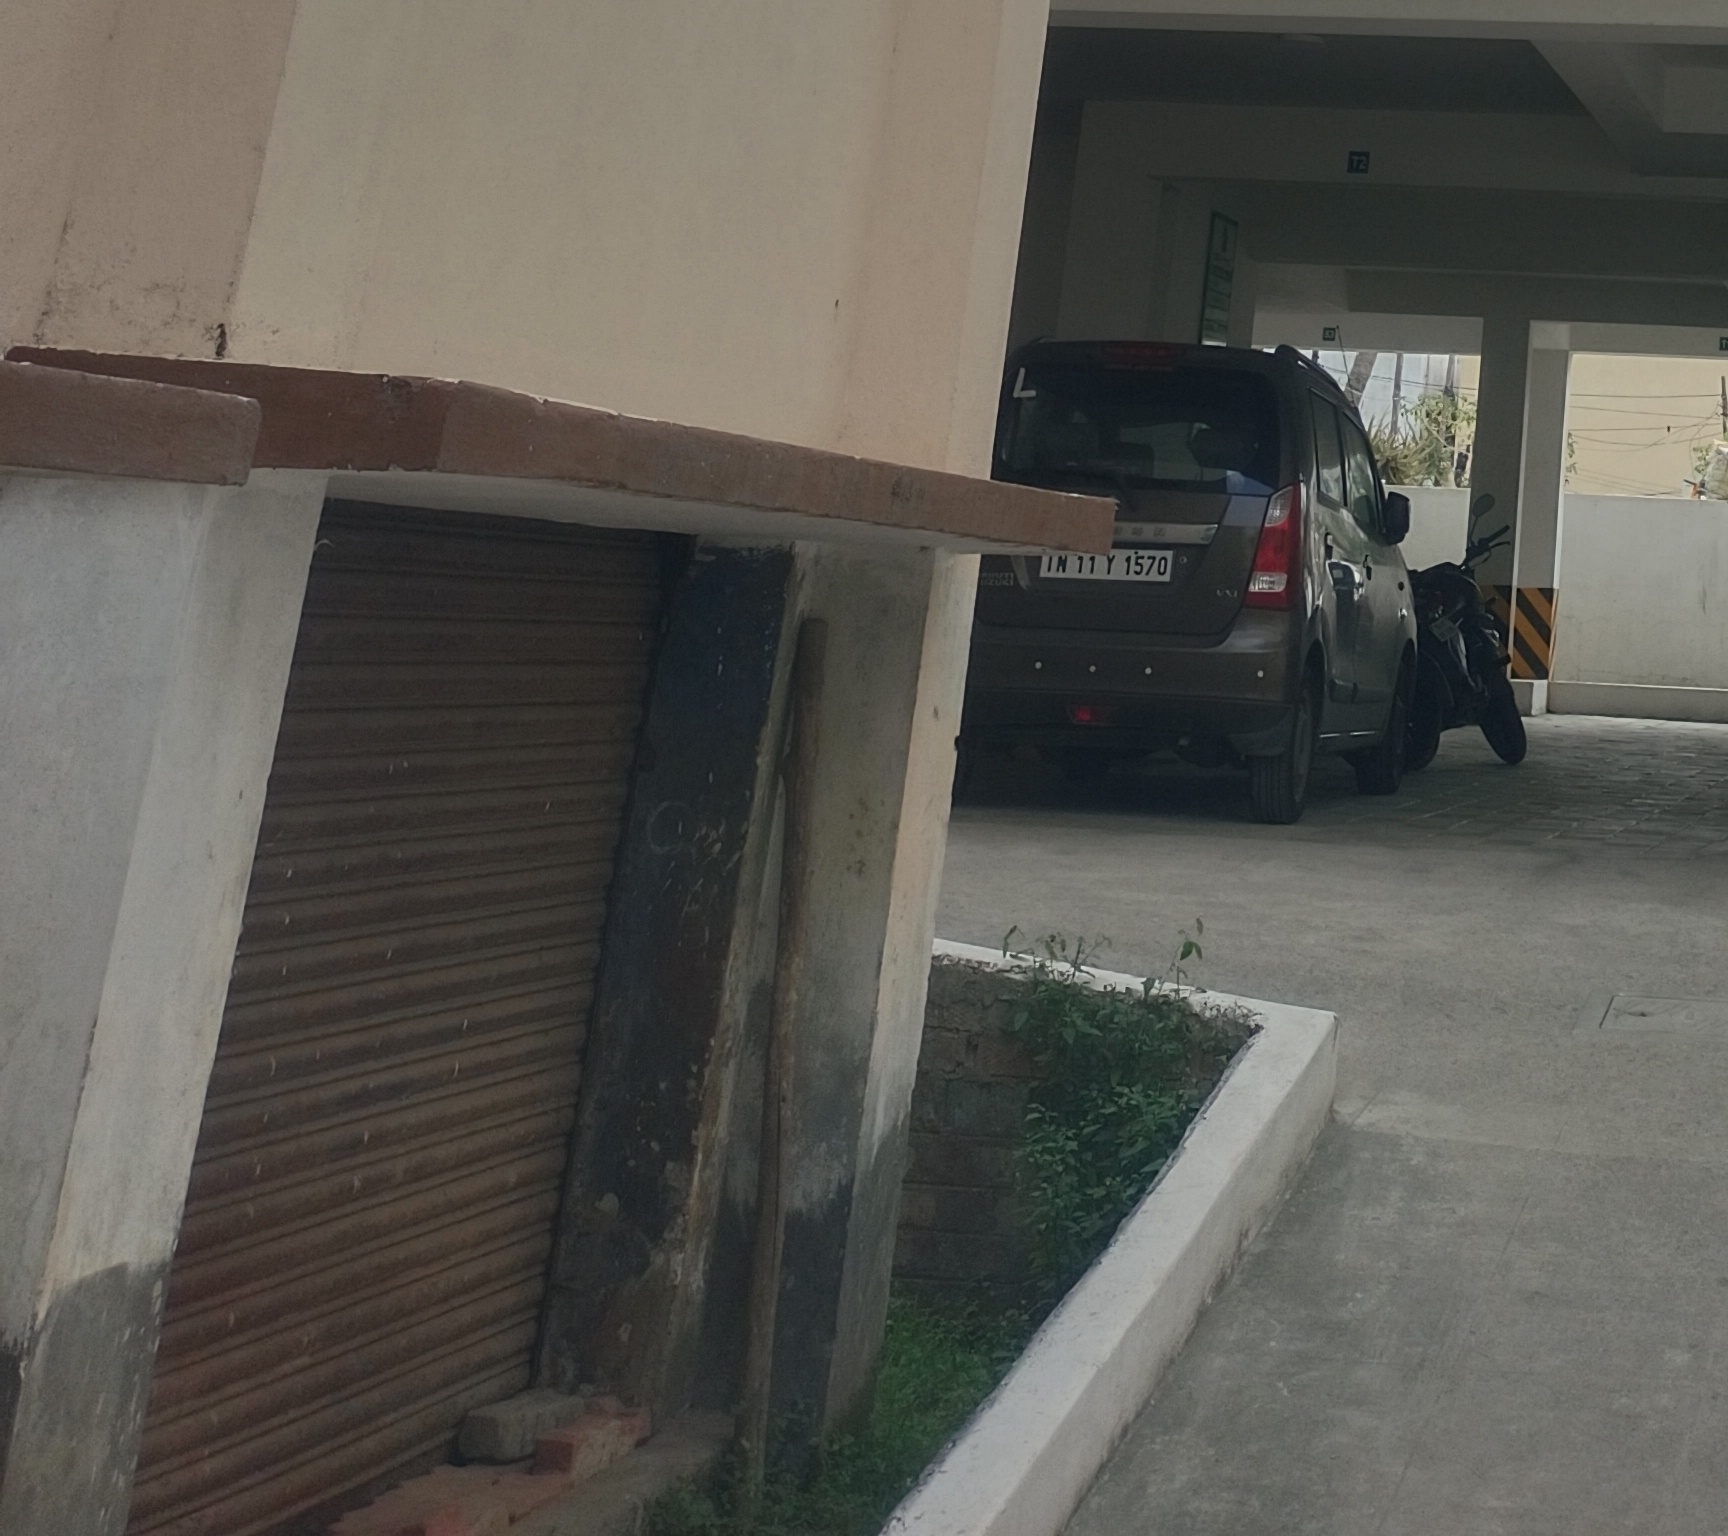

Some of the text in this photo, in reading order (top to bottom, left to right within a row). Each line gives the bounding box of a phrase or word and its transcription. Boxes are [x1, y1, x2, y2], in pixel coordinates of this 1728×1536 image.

[1351, 155, 1367, 169] T2
[1106, 554, 1116, 575] Y
[1125, 555, 1169, 576] 1570
